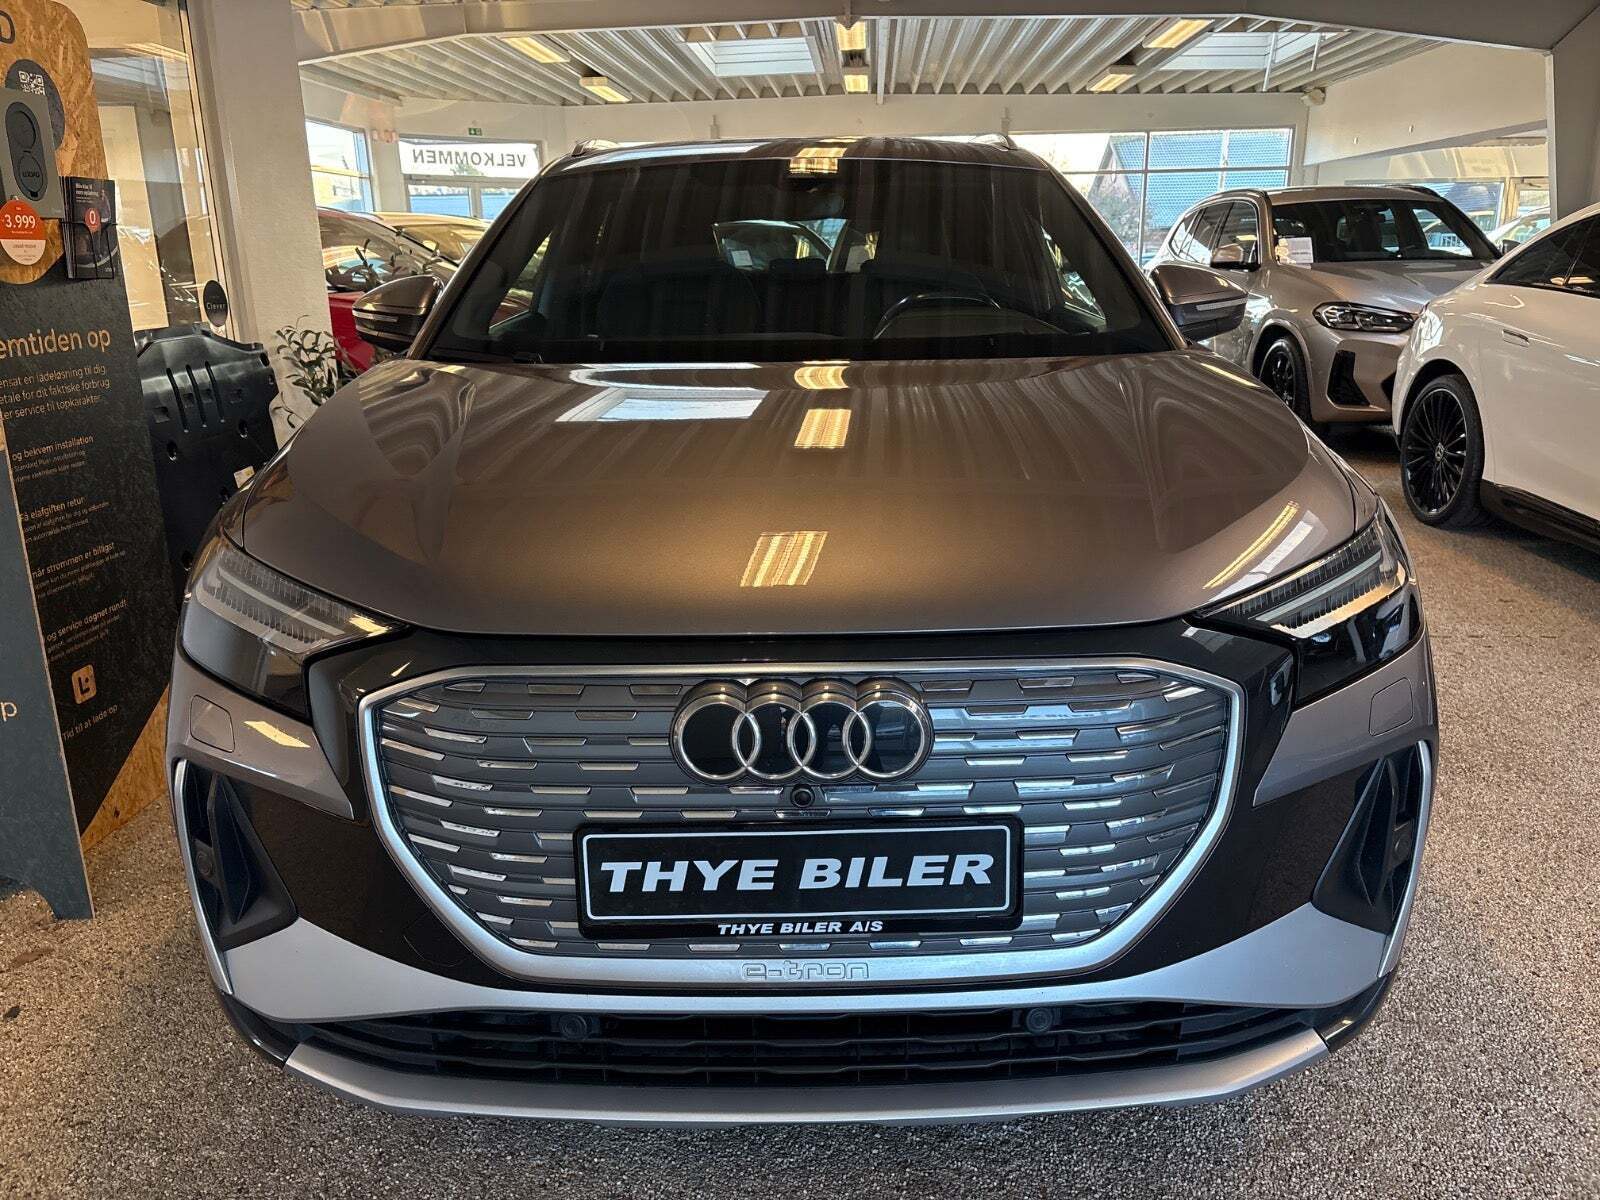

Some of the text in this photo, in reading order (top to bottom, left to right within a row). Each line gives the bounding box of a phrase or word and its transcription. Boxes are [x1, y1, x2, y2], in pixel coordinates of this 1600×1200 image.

[4, 214, 36, 228] 3.999
[87, 329, 111, 353] op
[93, 363, 106, 376] dig
[81, 378, 110, 392] forbrug
[15, 405, 45, 419] service
[55, 435, 94, 450] installation
[600, 853, 995, 893] THYE BILER
[717, 920, 884, 935] THYE BILER A/S
[741, 960, 870, 982] e-tron
